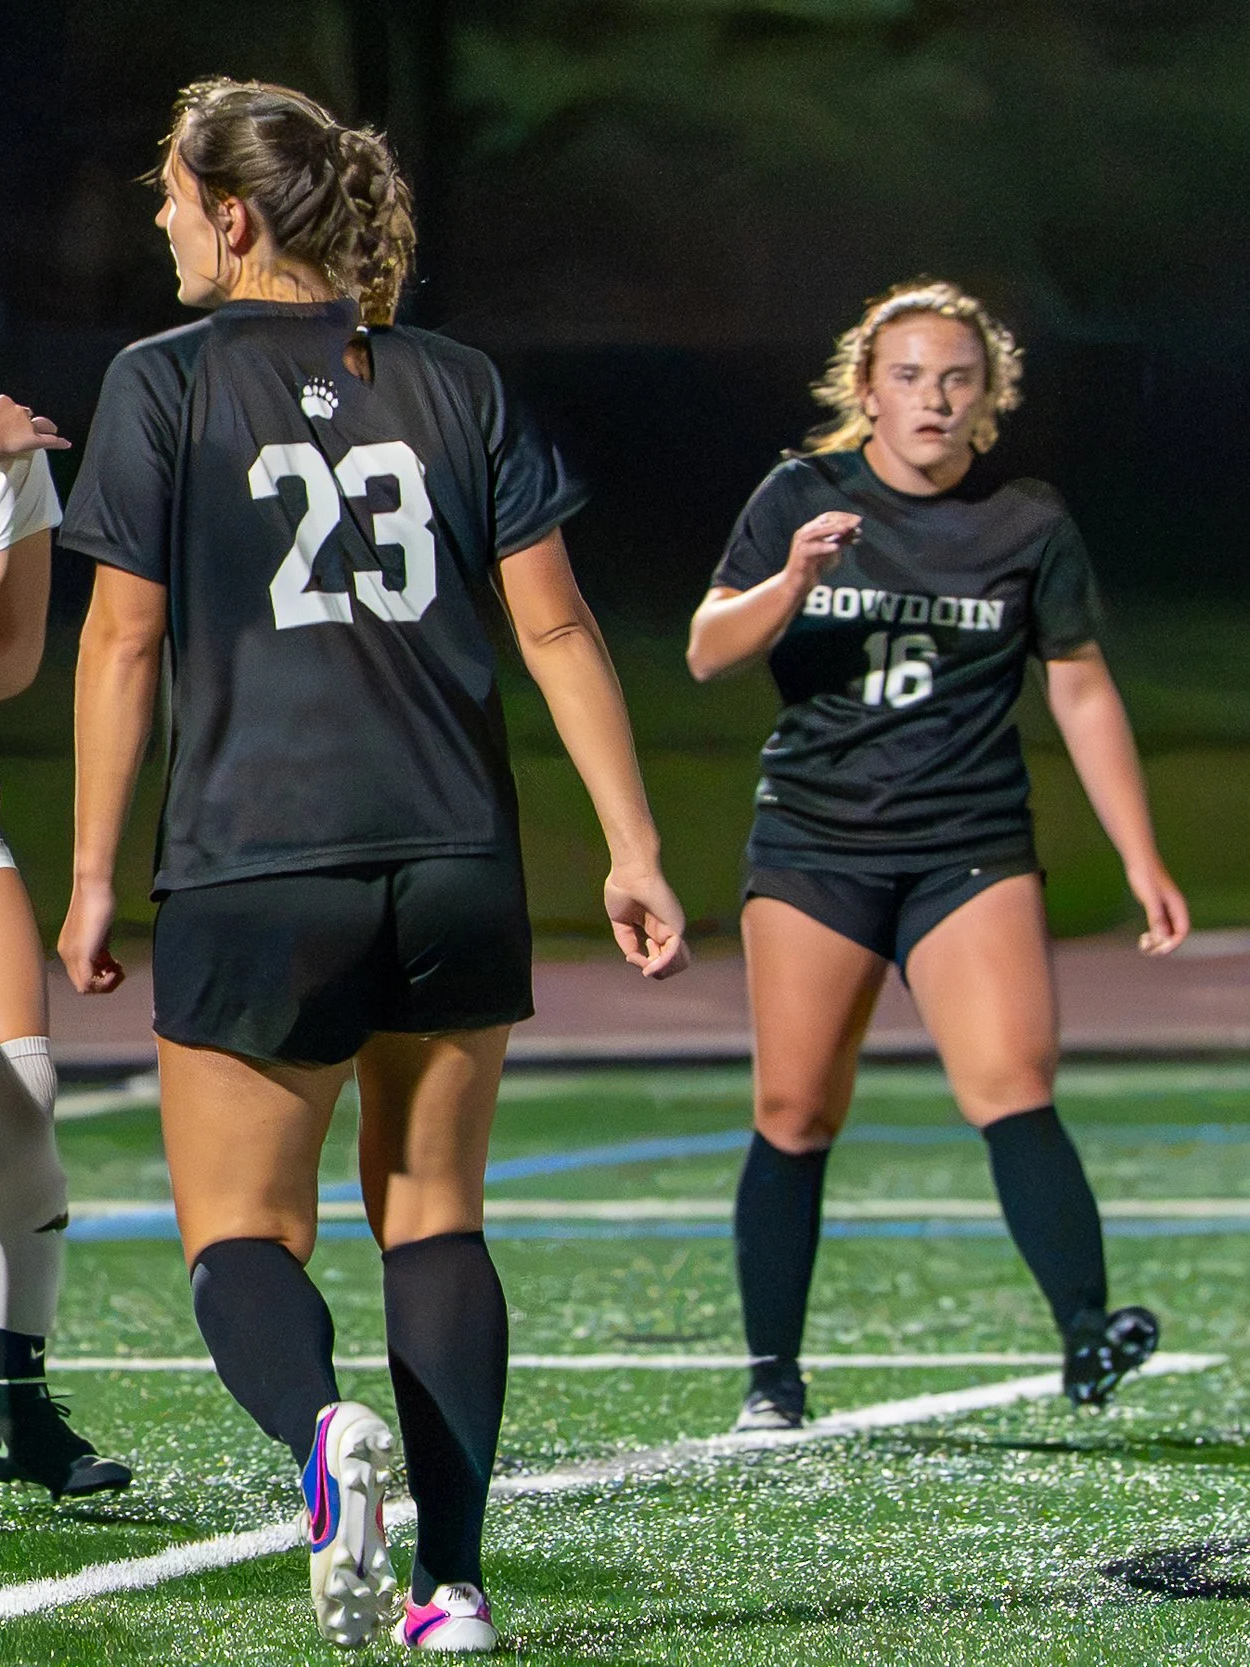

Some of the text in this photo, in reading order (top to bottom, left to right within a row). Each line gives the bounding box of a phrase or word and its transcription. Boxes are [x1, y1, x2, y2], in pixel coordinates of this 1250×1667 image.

[248, 440, 437, 630] 23
[803, 585, 1005, 631] BOWDOIN
[862, 631, 939, 709] 16
